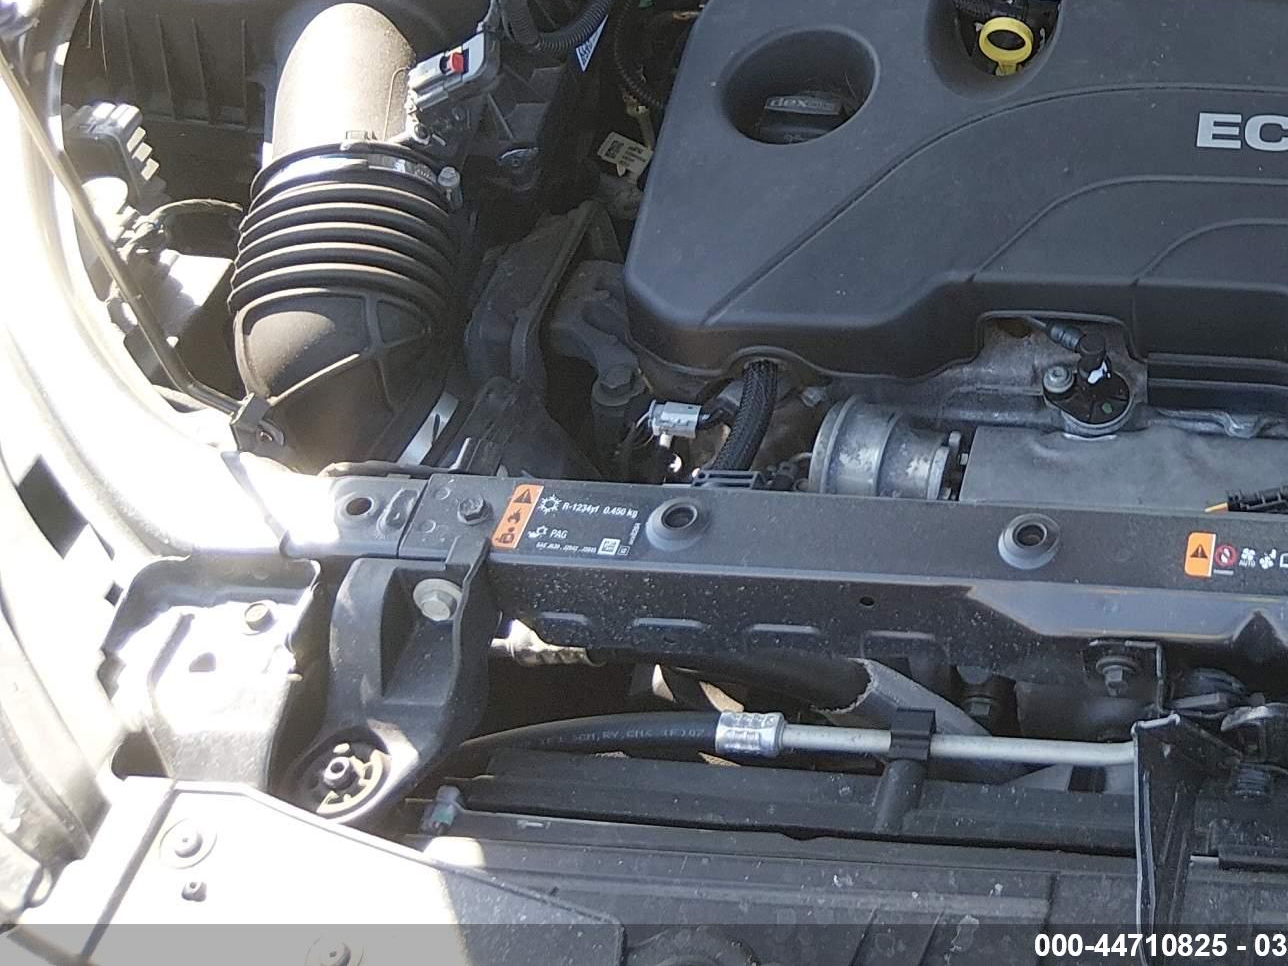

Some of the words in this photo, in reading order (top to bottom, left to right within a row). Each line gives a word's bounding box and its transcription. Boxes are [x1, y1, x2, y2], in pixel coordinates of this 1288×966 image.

[603, 506, 626, 515] 0.450
[626, 509, 639, 520] kg
[549, 529, 568, 539] PAG
[1239, 559, 1256, 568] AUTO
